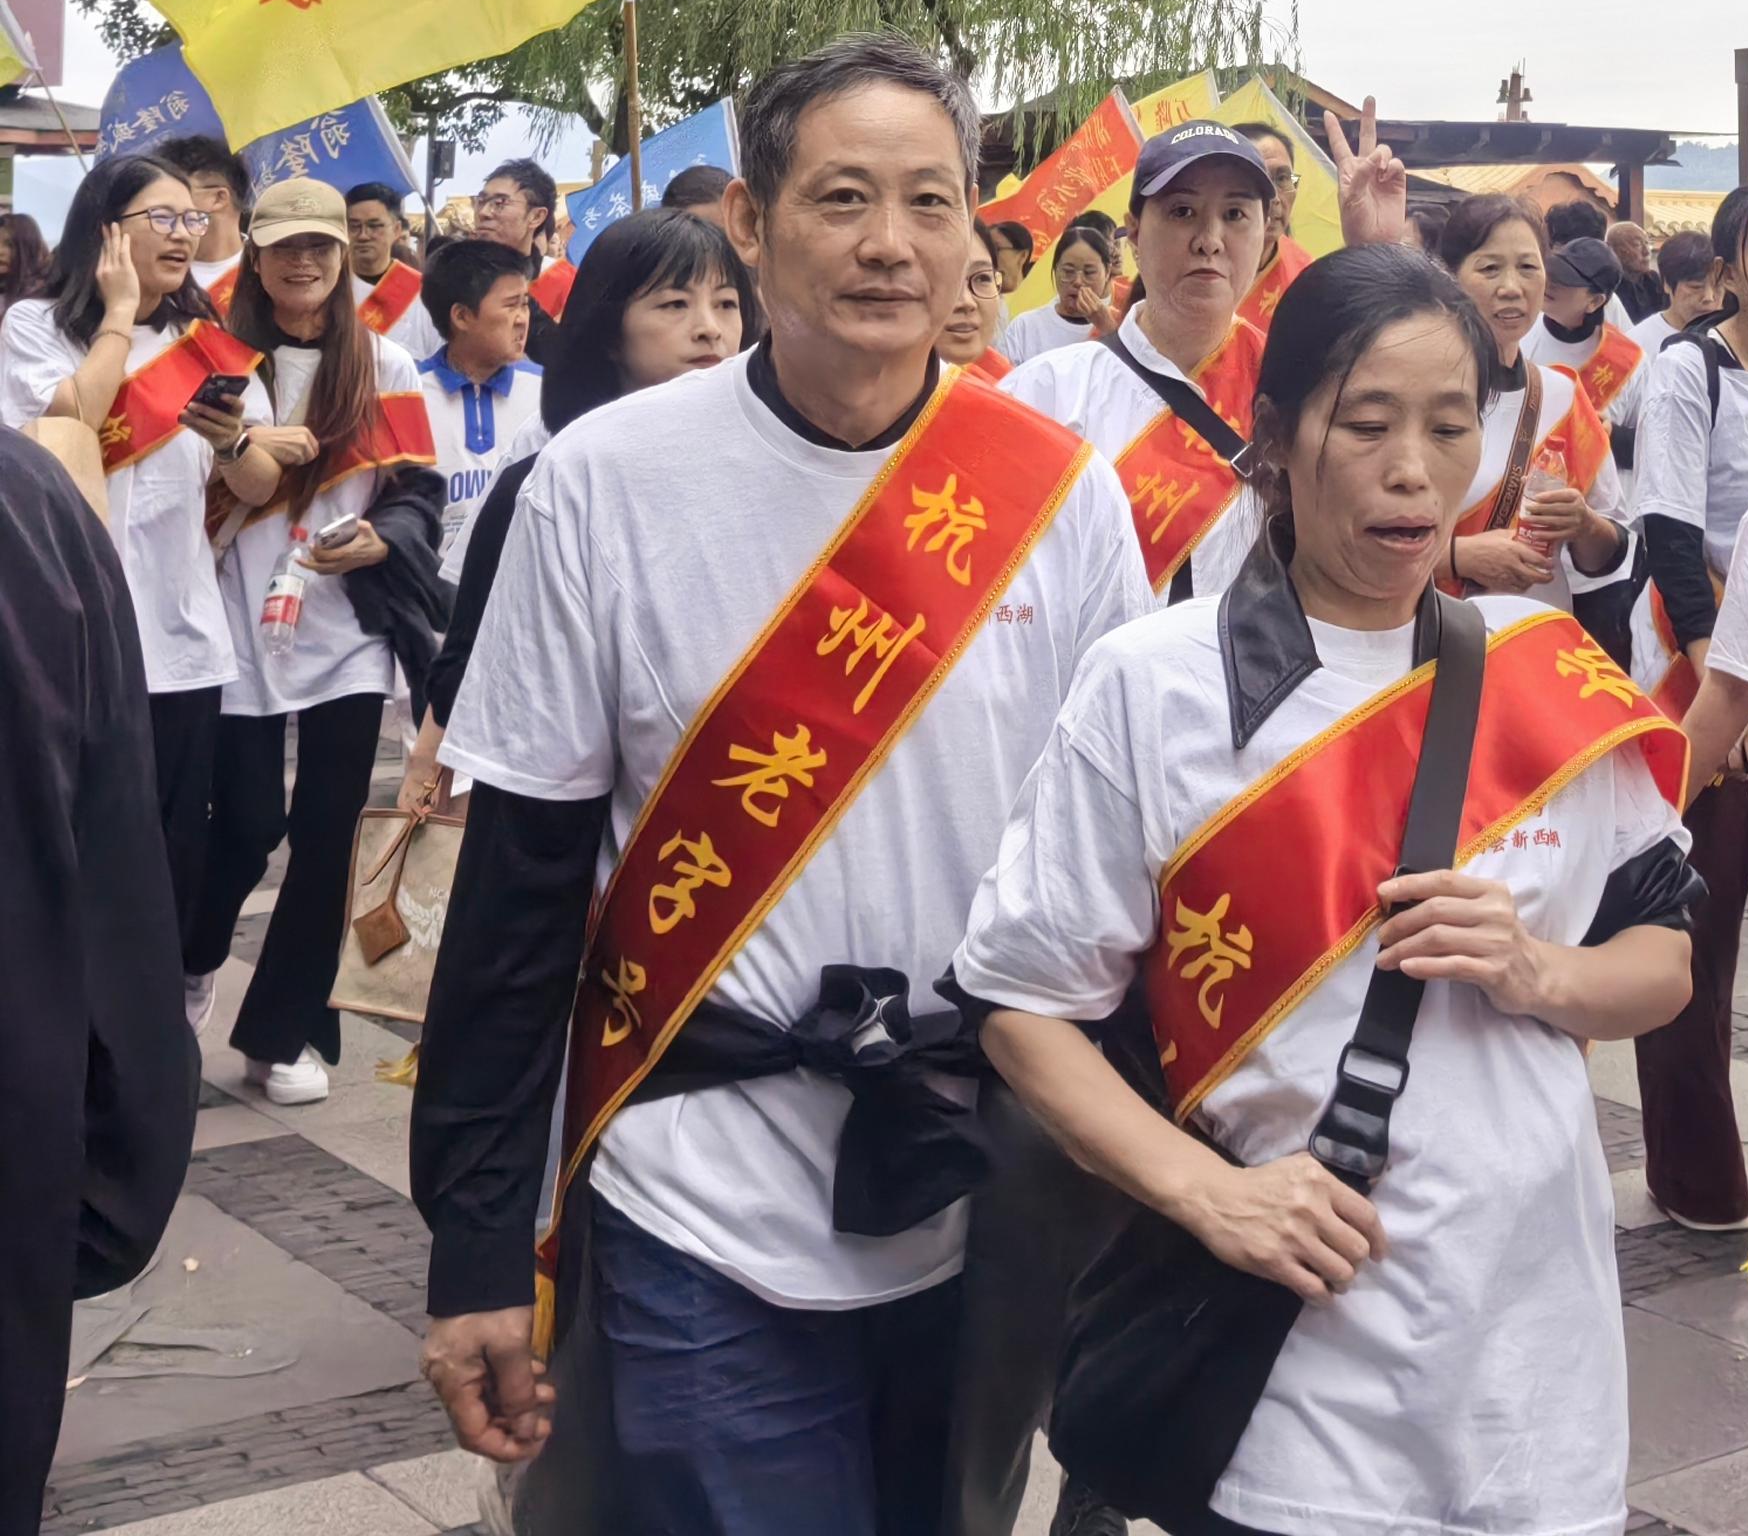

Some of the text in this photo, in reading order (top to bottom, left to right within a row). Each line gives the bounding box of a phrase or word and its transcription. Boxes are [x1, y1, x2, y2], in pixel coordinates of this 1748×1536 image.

[1170, 125, 1240, 145] COLORADO
[988, 602, 1034, 625] 西湖
[598, 472, 988, 1049] 杭州老字号
[1481, 826, 1562, 855] 会新西湖
[1154, 892, 1253, 1066] 杭
